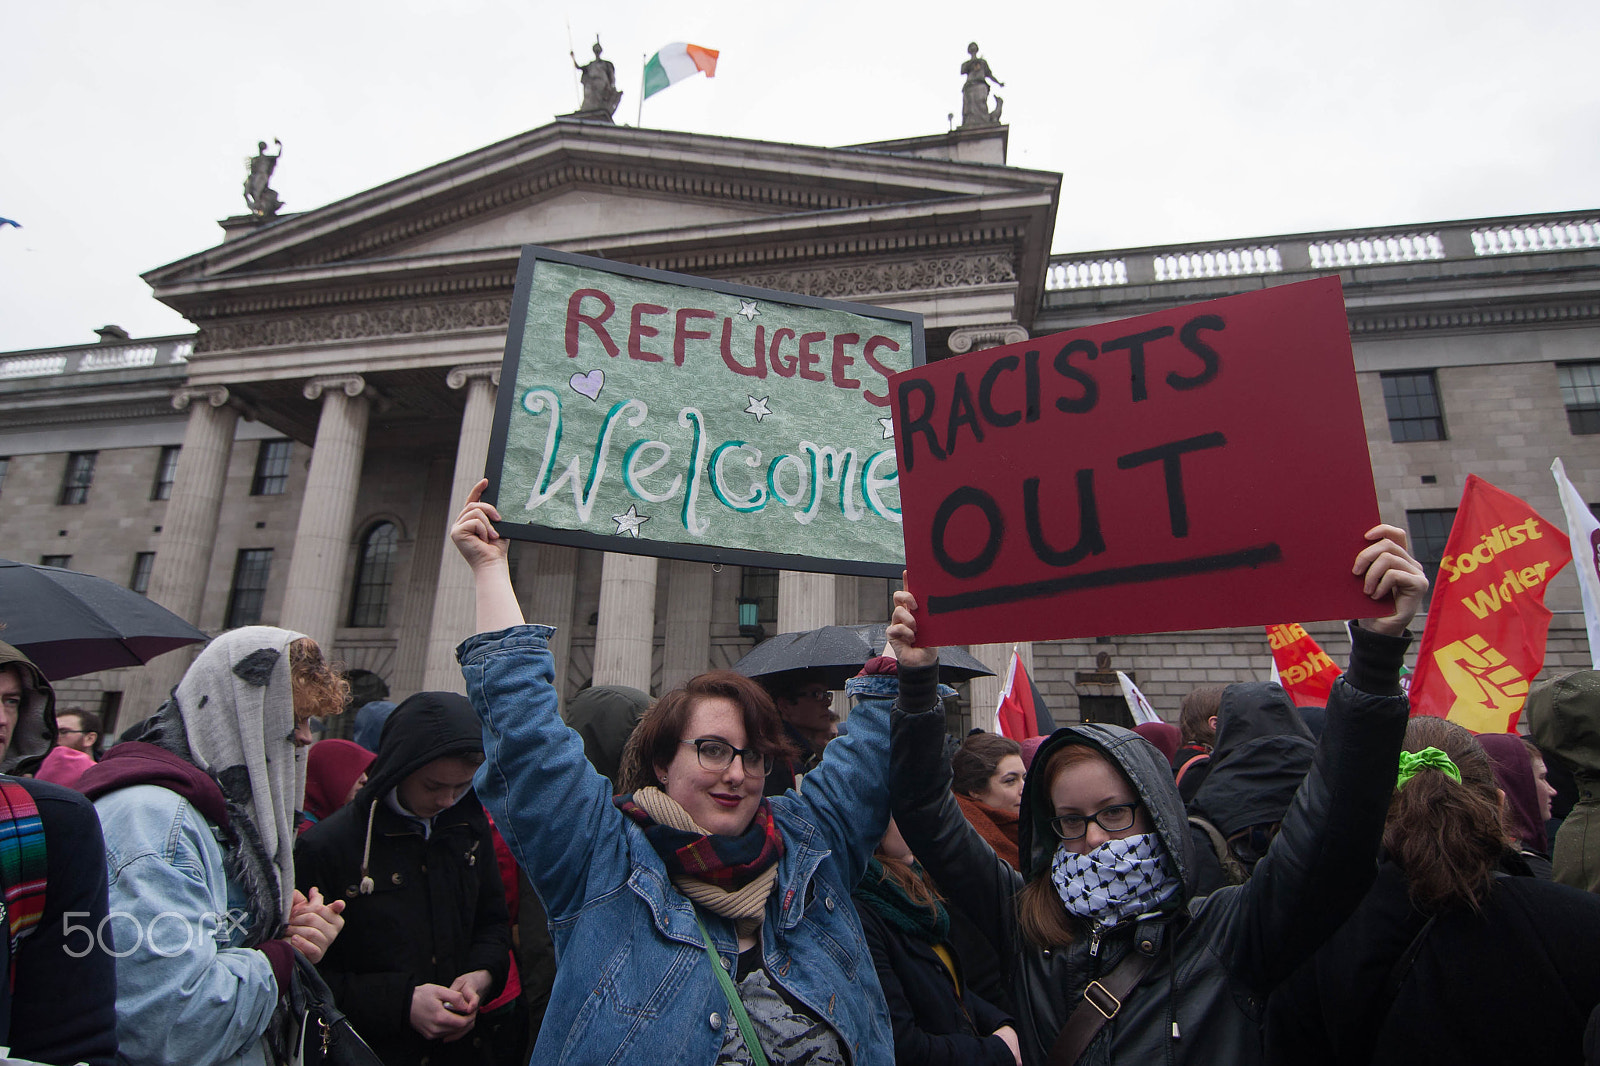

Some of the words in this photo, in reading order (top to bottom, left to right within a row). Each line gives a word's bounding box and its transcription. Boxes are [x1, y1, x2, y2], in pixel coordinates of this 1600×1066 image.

[565, 288, 900, 407] REFUGEES
[898, 314, 1226, 472] RACISTS
[520, 384, 903, 536] Welcome
[931, 431, 1227, 580] OUT
